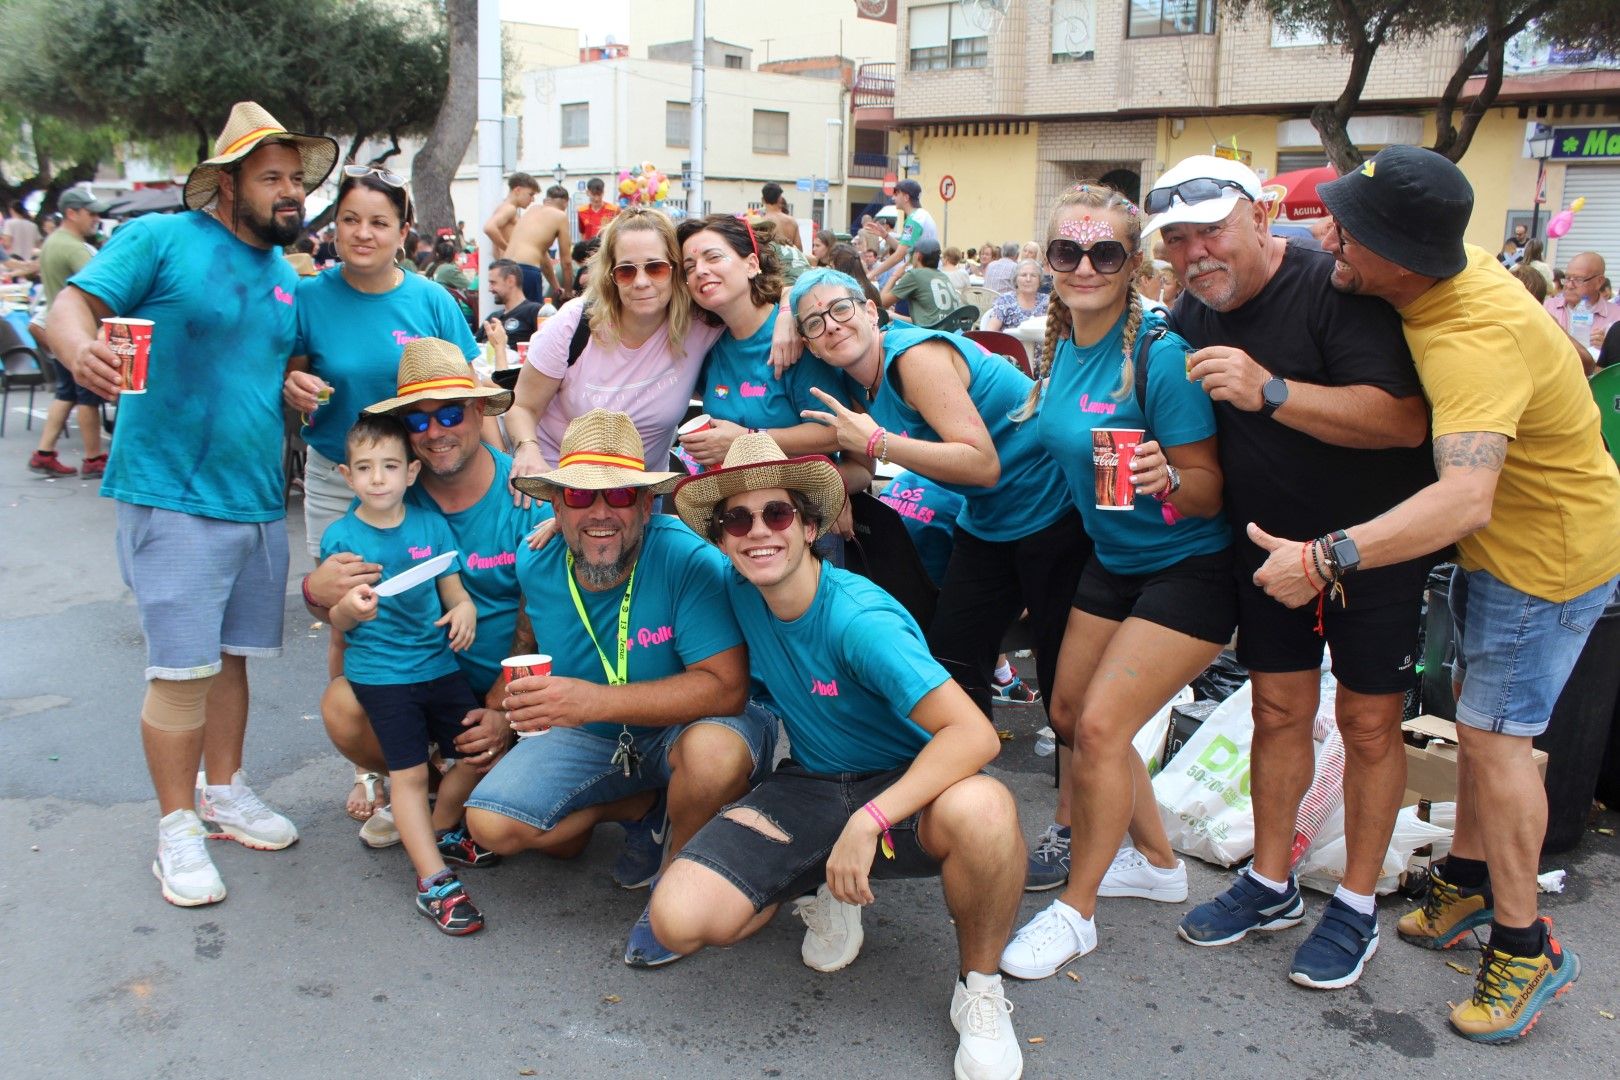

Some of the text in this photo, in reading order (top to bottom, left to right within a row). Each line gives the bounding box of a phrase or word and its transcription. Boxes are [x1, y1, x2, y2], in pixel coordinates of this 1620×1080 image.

[1293, 206, 1321, 216] AGUILA
[1510, 963, 1549, 1019] new balance
